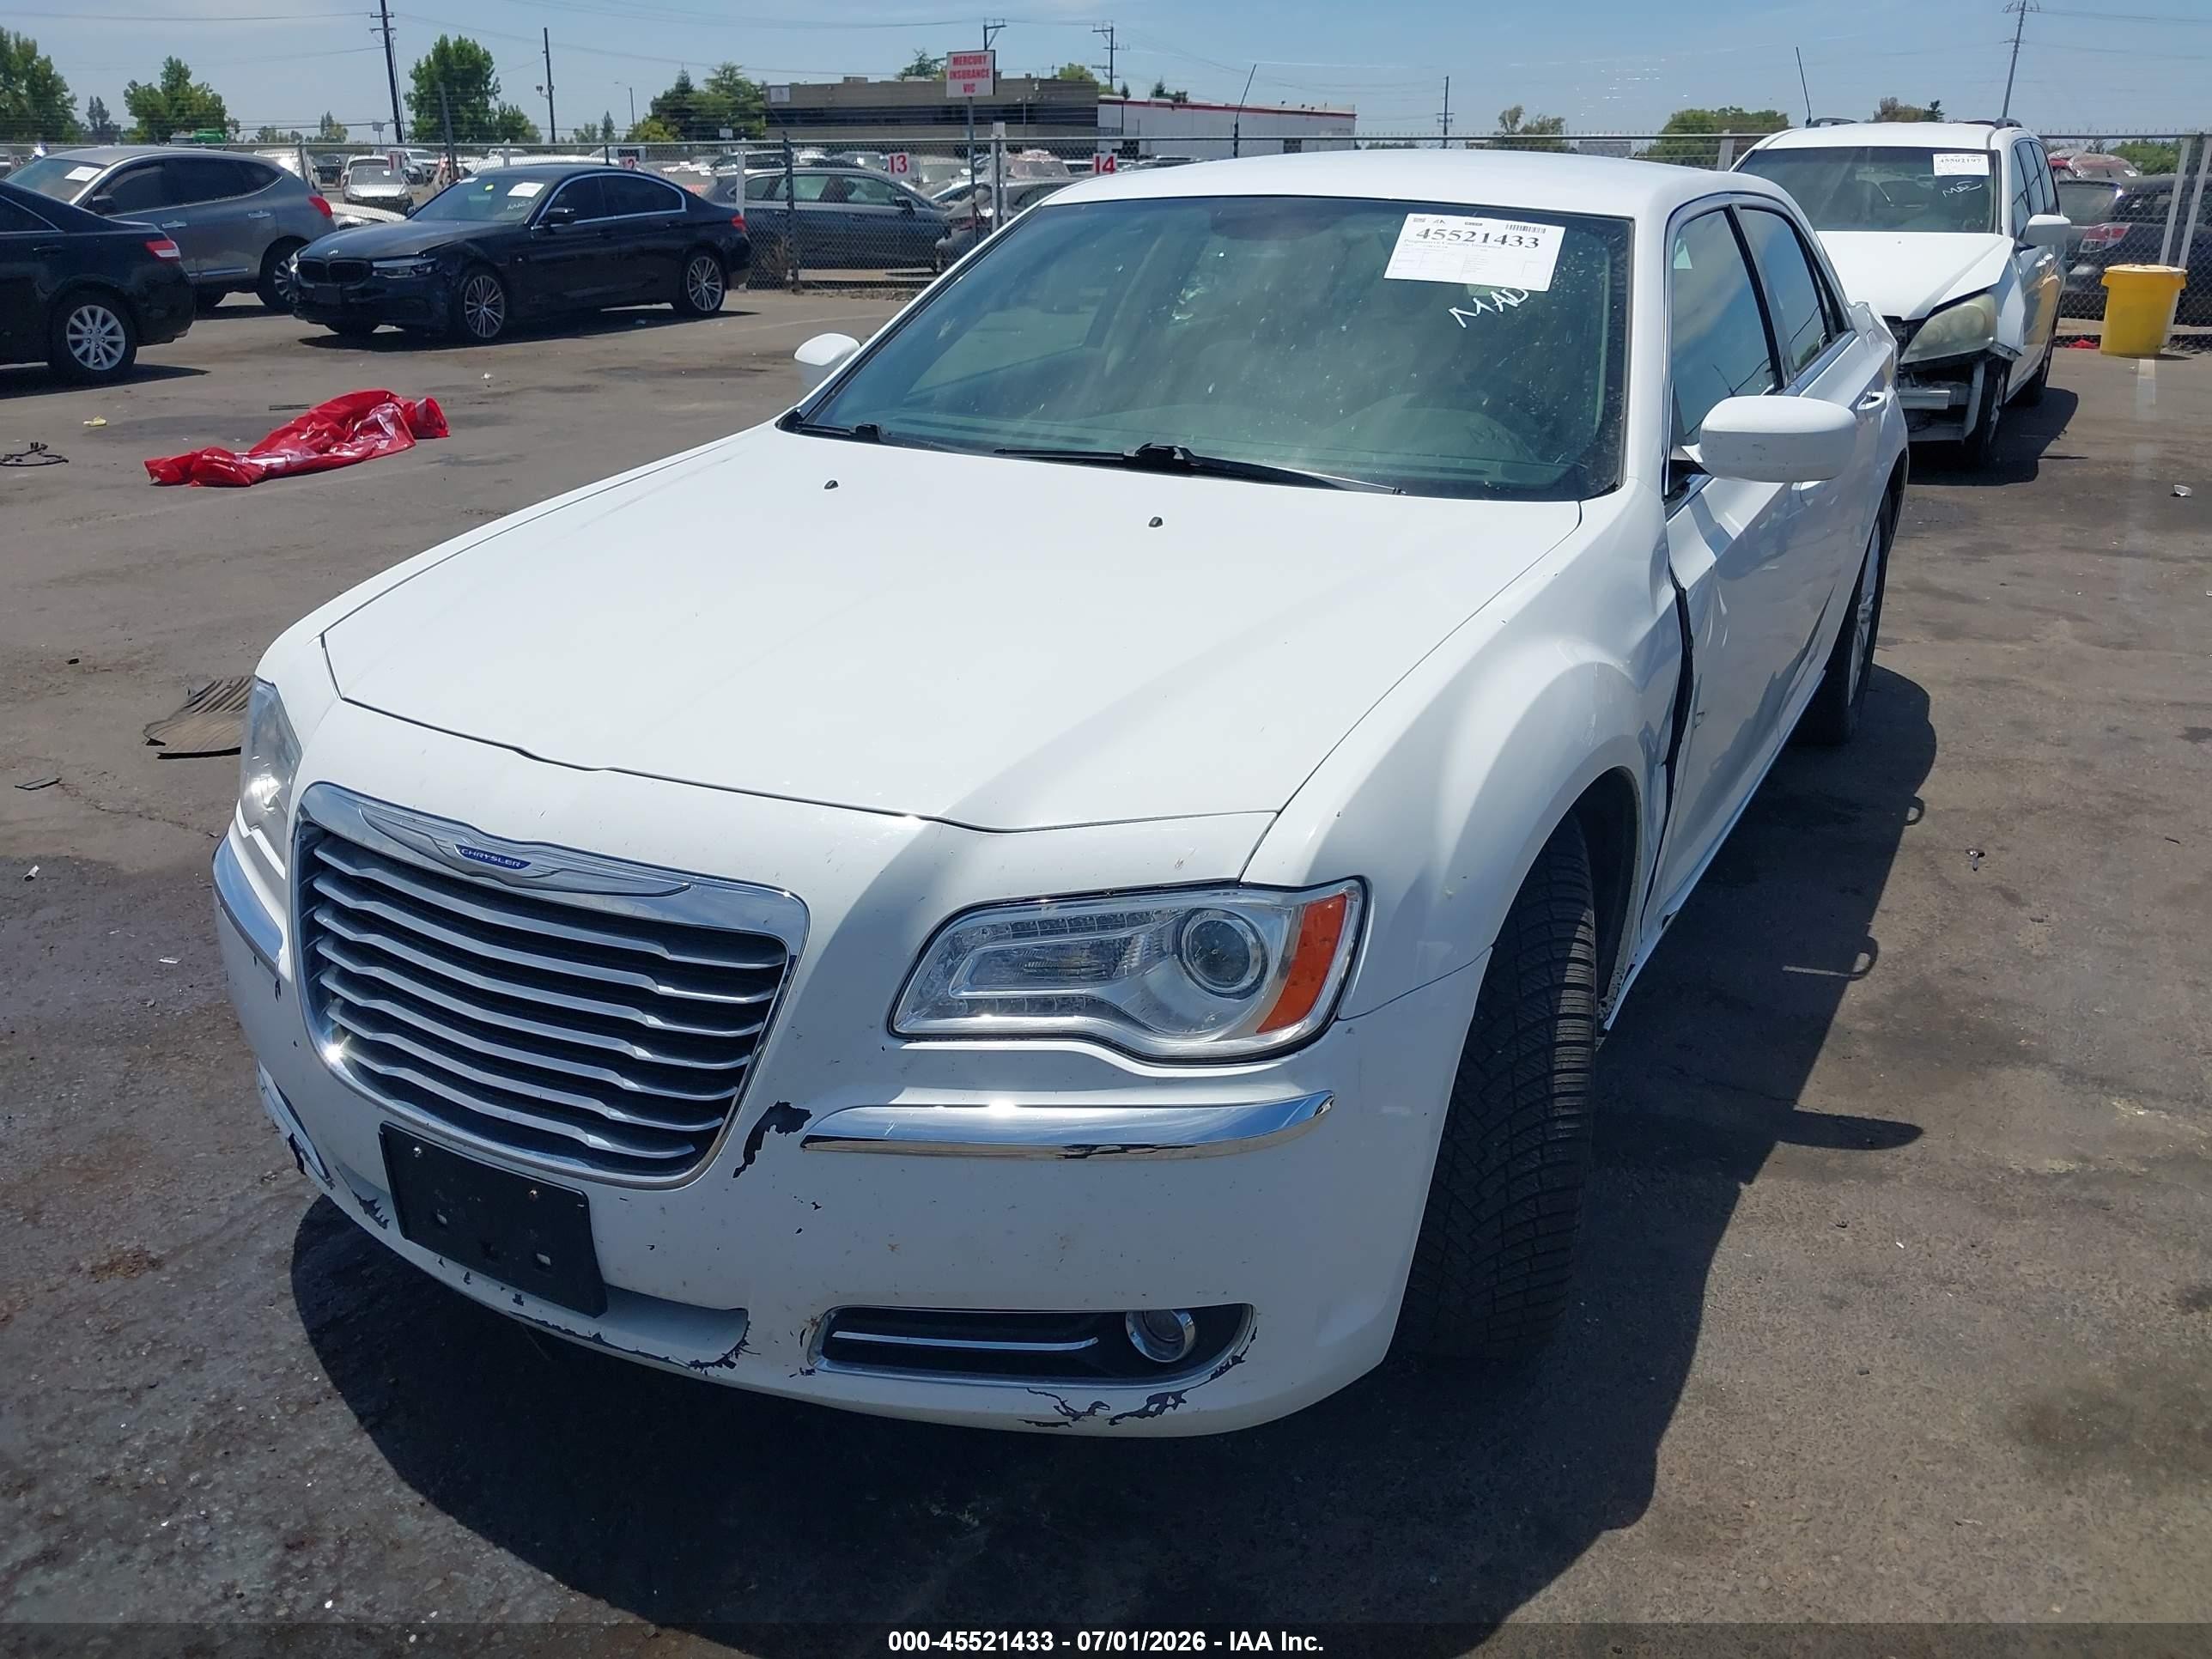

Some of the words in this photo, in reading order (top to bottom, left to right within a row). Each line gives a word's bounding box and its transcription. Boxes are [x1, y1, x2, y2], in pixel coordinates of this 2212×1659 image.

[952, 55, 988, 66] MERCURY
[949, 69, 990, 80] INSURANCE
[963, 82, 975, 94] VIC
[890, 155, 908, 174] 13
[1095, 155, 1116, 174] 14
[1416, 228, 1540, 249] 45521433
[460, 848, 521, 868] CHRYSLER
